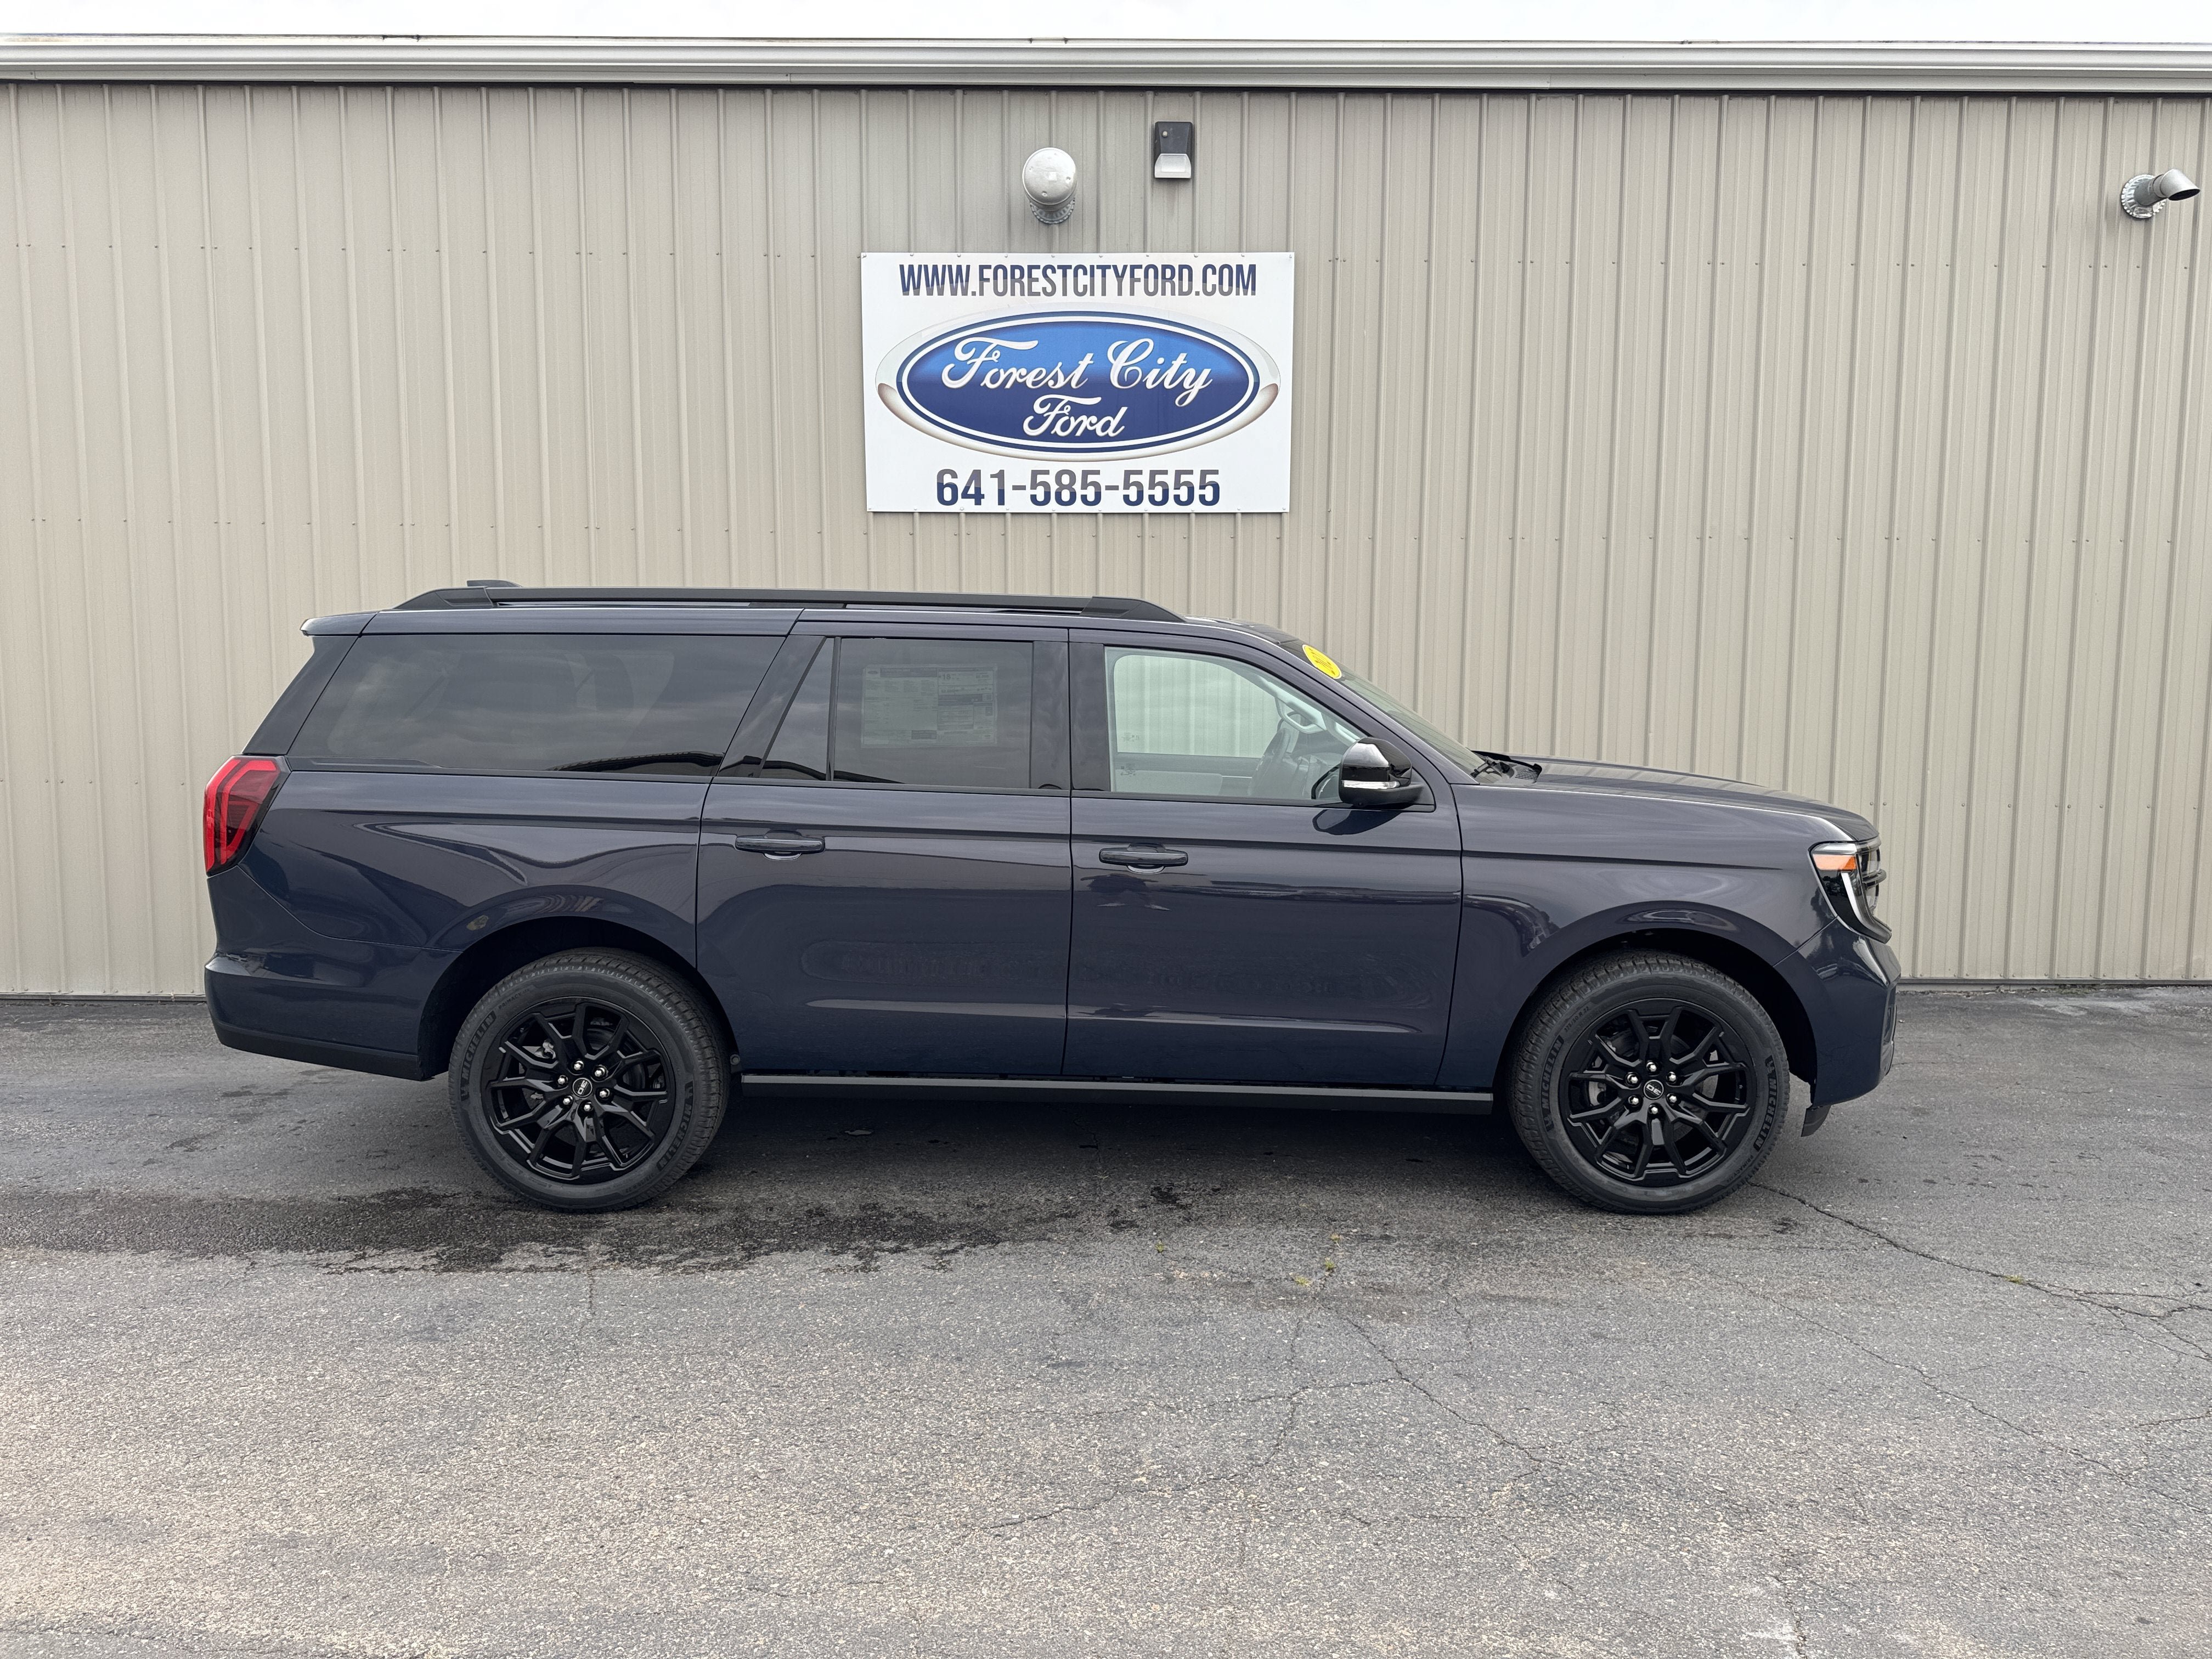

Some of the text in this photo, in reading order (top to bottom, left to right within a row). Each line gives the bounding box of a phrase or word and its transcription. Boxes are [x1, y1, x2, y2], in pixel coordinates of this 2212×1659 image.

[899, 264, 1256, 297] WWW.FORESTCITYFORD.COM
[941, 336, 1213, 408] Forest City
[1022, 394, 1128, 438] Ford
[936, 469, 1221, 507] 641-585-5555
[461, 1013, 495, 1080] MICHELIN
[1541, 1036, 1564, 1109] MICHELIN
[660, 1104, 693, 1169] MICHELIN
[1756, 1078, 1777, 1149] MICHELIN
